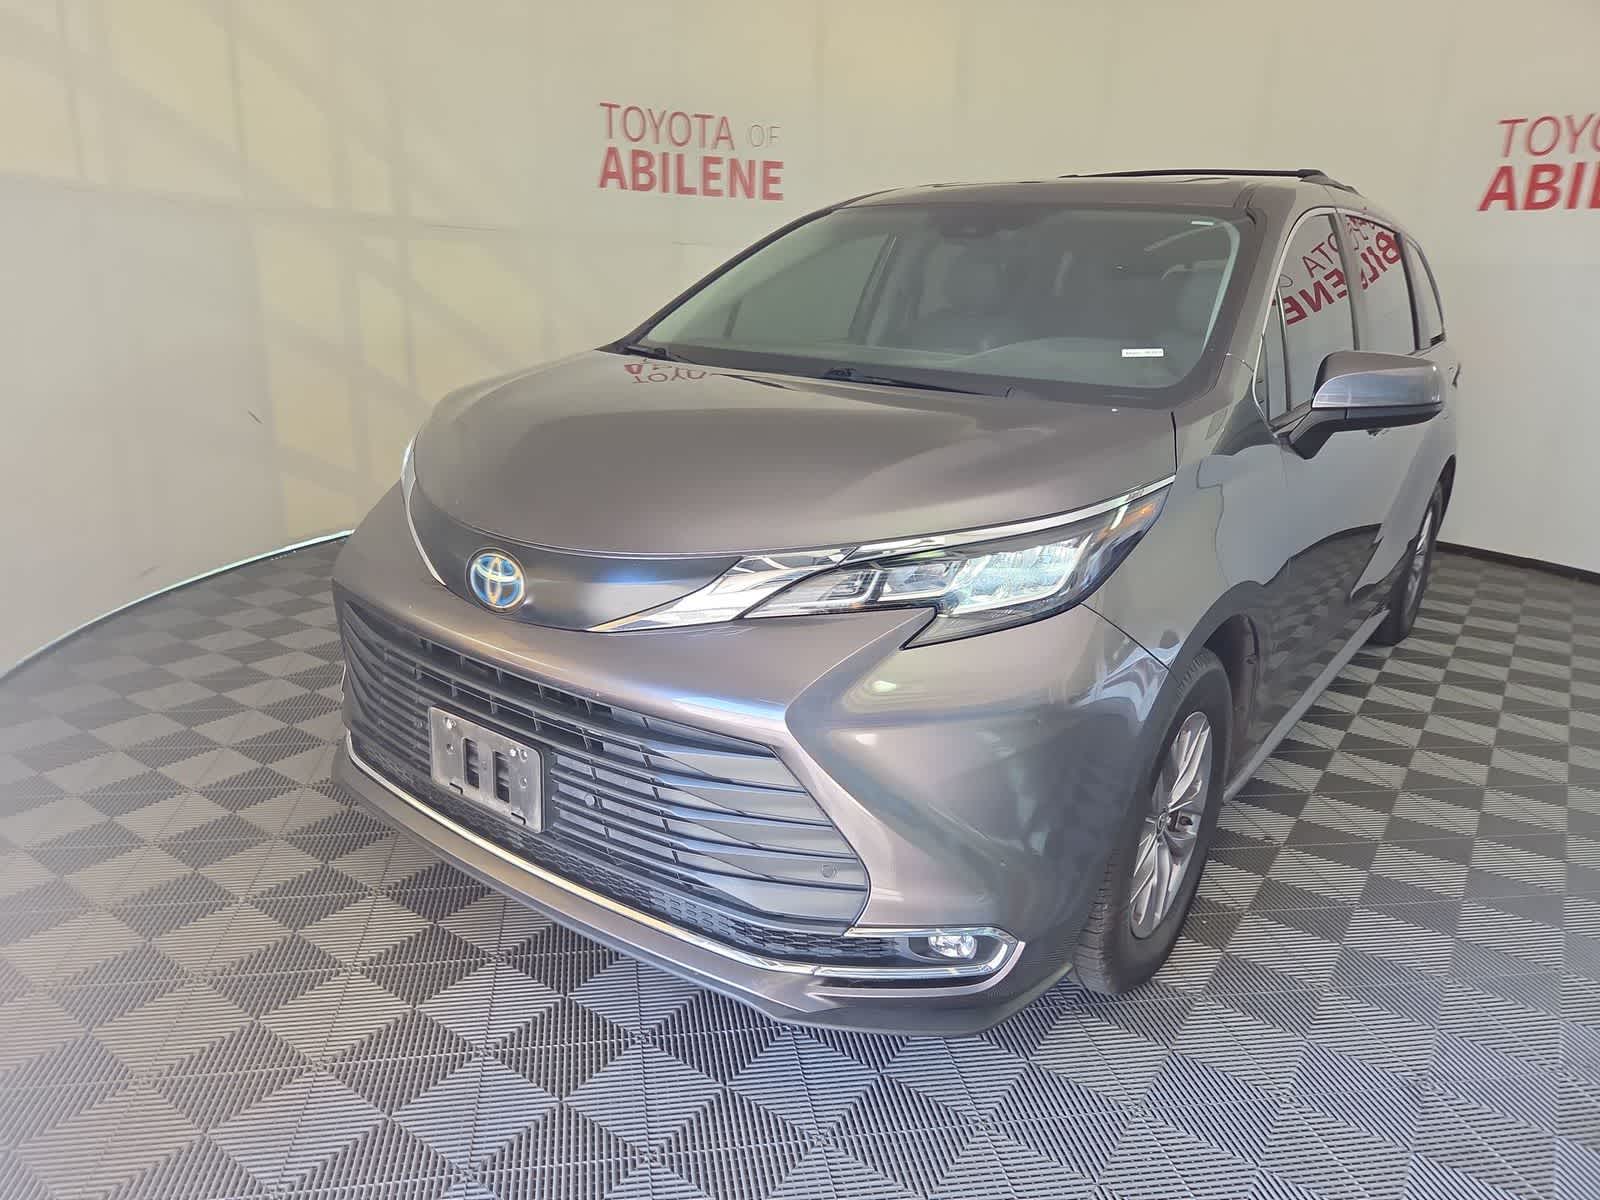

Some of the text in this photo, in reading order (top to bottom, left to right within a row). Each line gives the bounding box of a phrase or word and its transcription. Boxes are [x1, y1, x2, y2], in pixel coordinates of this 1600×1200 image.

[599, 102, 781, 151] TOYOTA OF
[1497, 113, 1600, 158] TOY
[598, 146, 784, 201] ABILENE
